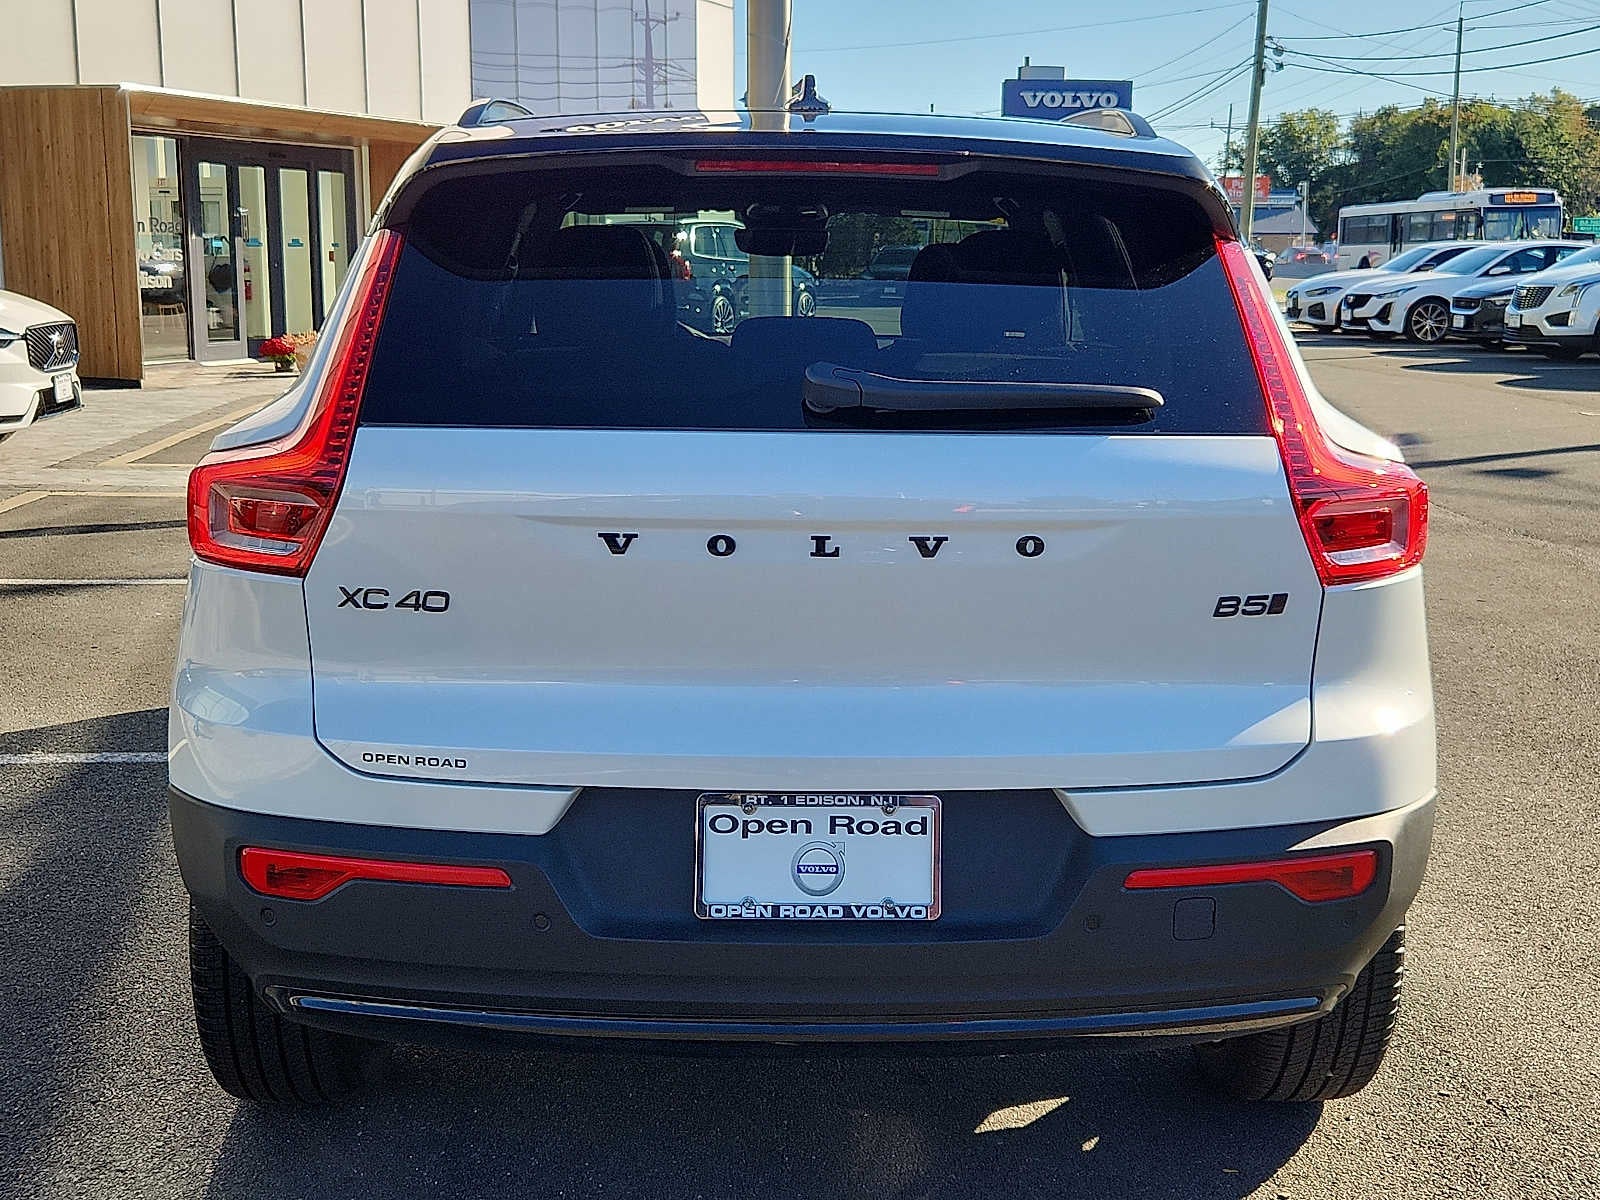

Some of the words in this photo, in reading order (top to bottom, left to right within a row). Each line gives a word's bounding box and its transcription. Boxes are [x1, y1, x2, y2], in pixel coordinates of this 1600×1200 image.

[1020, 91, 1118, 108] VOLVO
[598, 533, 1045, 558] VOLVO
[362, 752, 410, 765] OPEN
[415, 756, 467, 769] ROAD
[745, 795, 772, 805] RT.
[781, 795, 788, 805] 1
[795, 795, 865, 806] EDISON,
[708, 813, 813, 839] Open
[828, 815, 928, 835] Road
[799, 865, 837, 873] VOLVO
[710, 904, 772, 918] OPEN
[779, 904, 843, 918] ROAD
[850, 904, 927, 918] VOLVO
